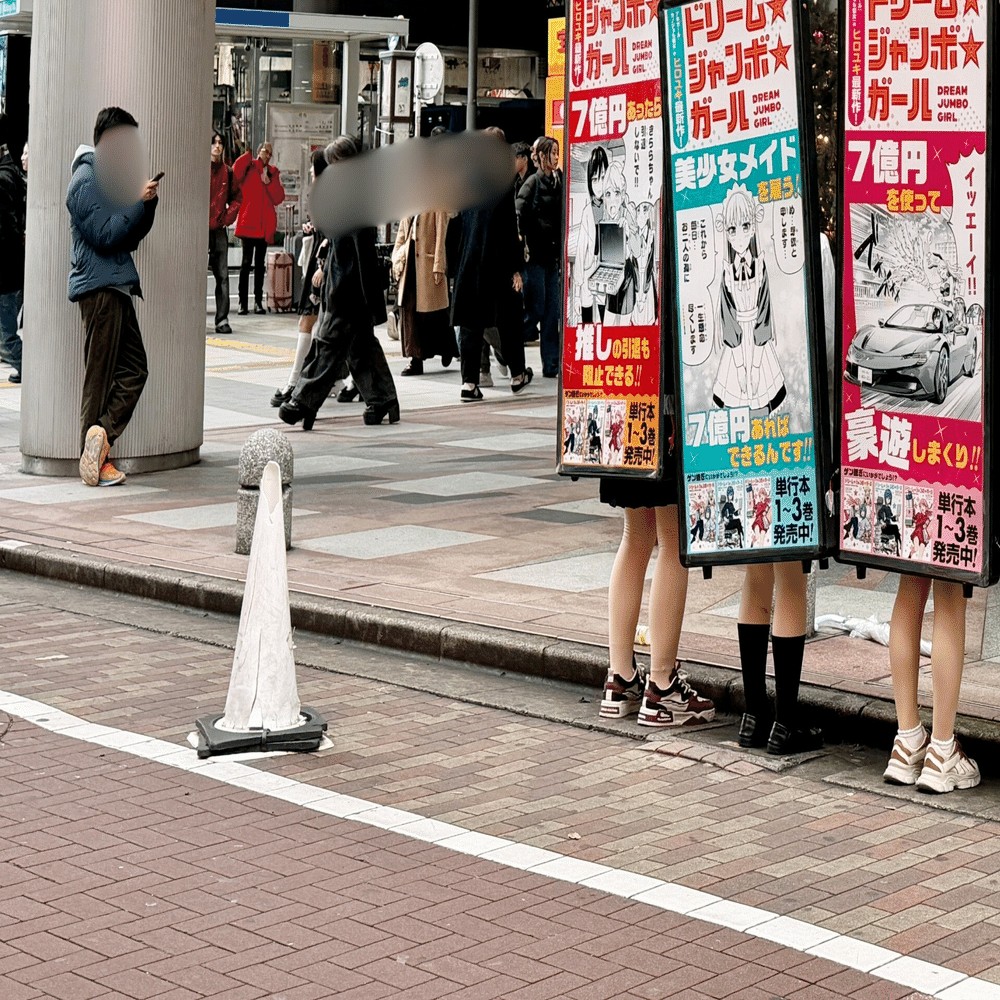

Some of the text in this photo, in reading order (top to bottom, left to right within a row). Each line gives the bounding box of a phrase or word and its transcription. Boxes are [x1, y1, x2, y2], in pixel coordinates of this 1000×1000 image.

[632, 38, 653, 51] DREAM
[632, 51, 653, 63] JUMBO
[632, 63, 647, 74] GIRL
[752, 89, 780, 105] DREAM
[868, 77, 932, 122] ガール
[937, 85, 968, 96] DREAM
[753, 102, 782, 116] JUMBO
[937, 98, 968, 110] JUMBO
[690, 92, 750, 140] ガール
[754, 115, 773, 128] GIRL
[937, 112, 958, 122] GIRL
[675, 135, 797, 192] 美少女メイド
[848, 140, 928, 185] 7億円
[886, 188, 941, 214] を使って
[629, 401, 656, 422] 単行本
[687, 407, 790, 447] 7億円あれば
[775, 475, 811, 498] 単行本
[937, 490, 977, 519] 単行本
[773, 523, 814, 545] 発売中!
[932, 541, 977, 569] 発売中!
